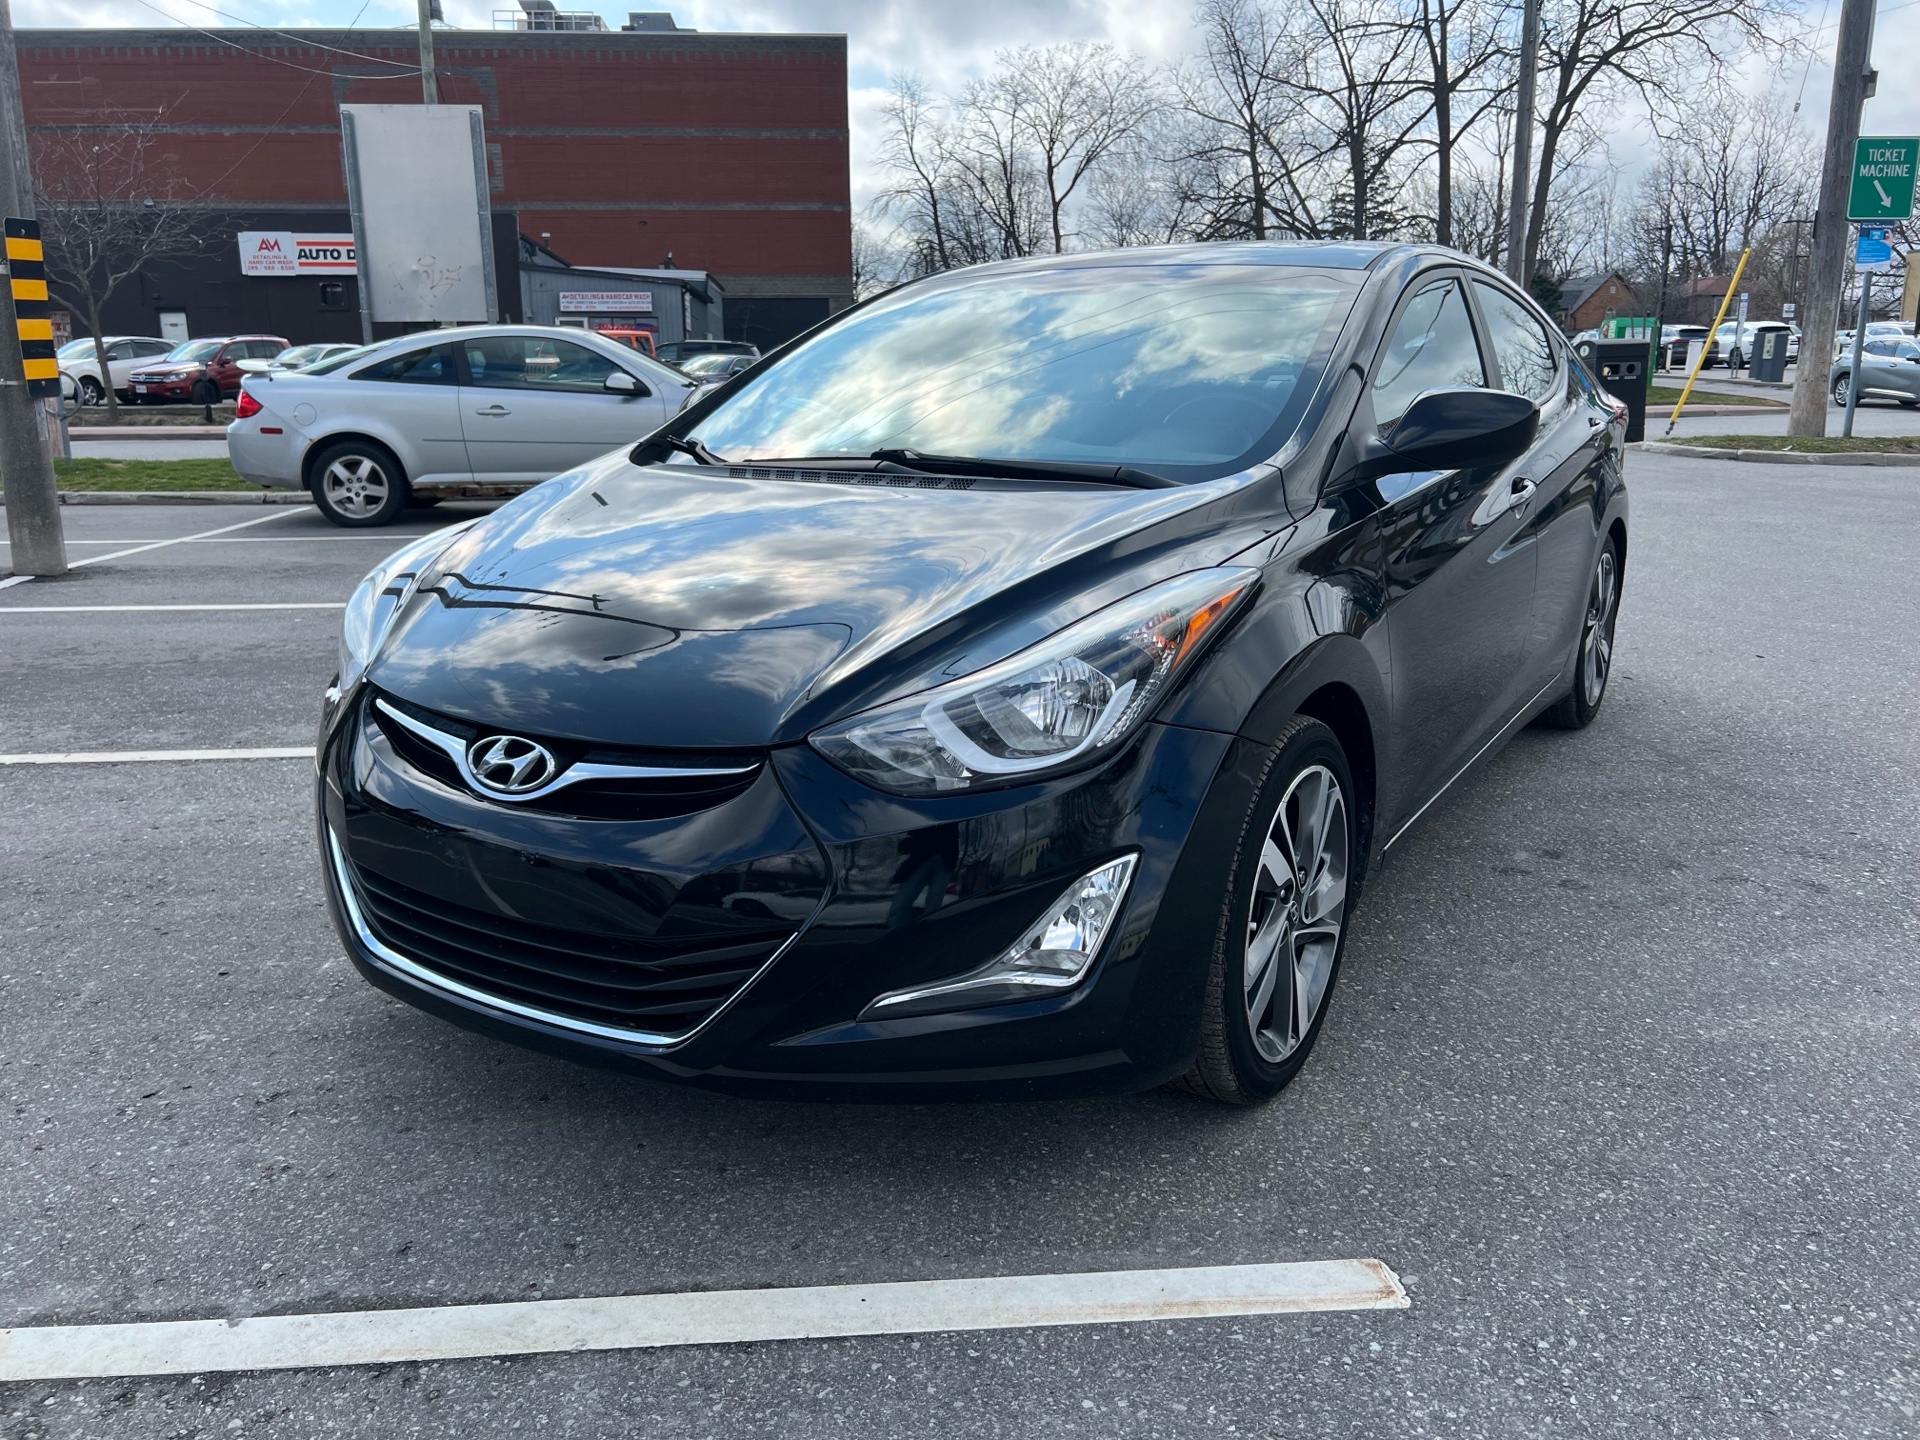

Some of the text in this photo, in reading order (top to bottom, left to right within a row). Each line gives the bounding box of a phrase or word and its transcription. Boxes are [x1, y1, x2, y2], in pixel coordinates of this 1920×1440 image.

[1868, 148, 1907, 162] TICKET
[1859, 164, 1911, 177] MACHINE
[297, 248, 342, 260] AUTO
